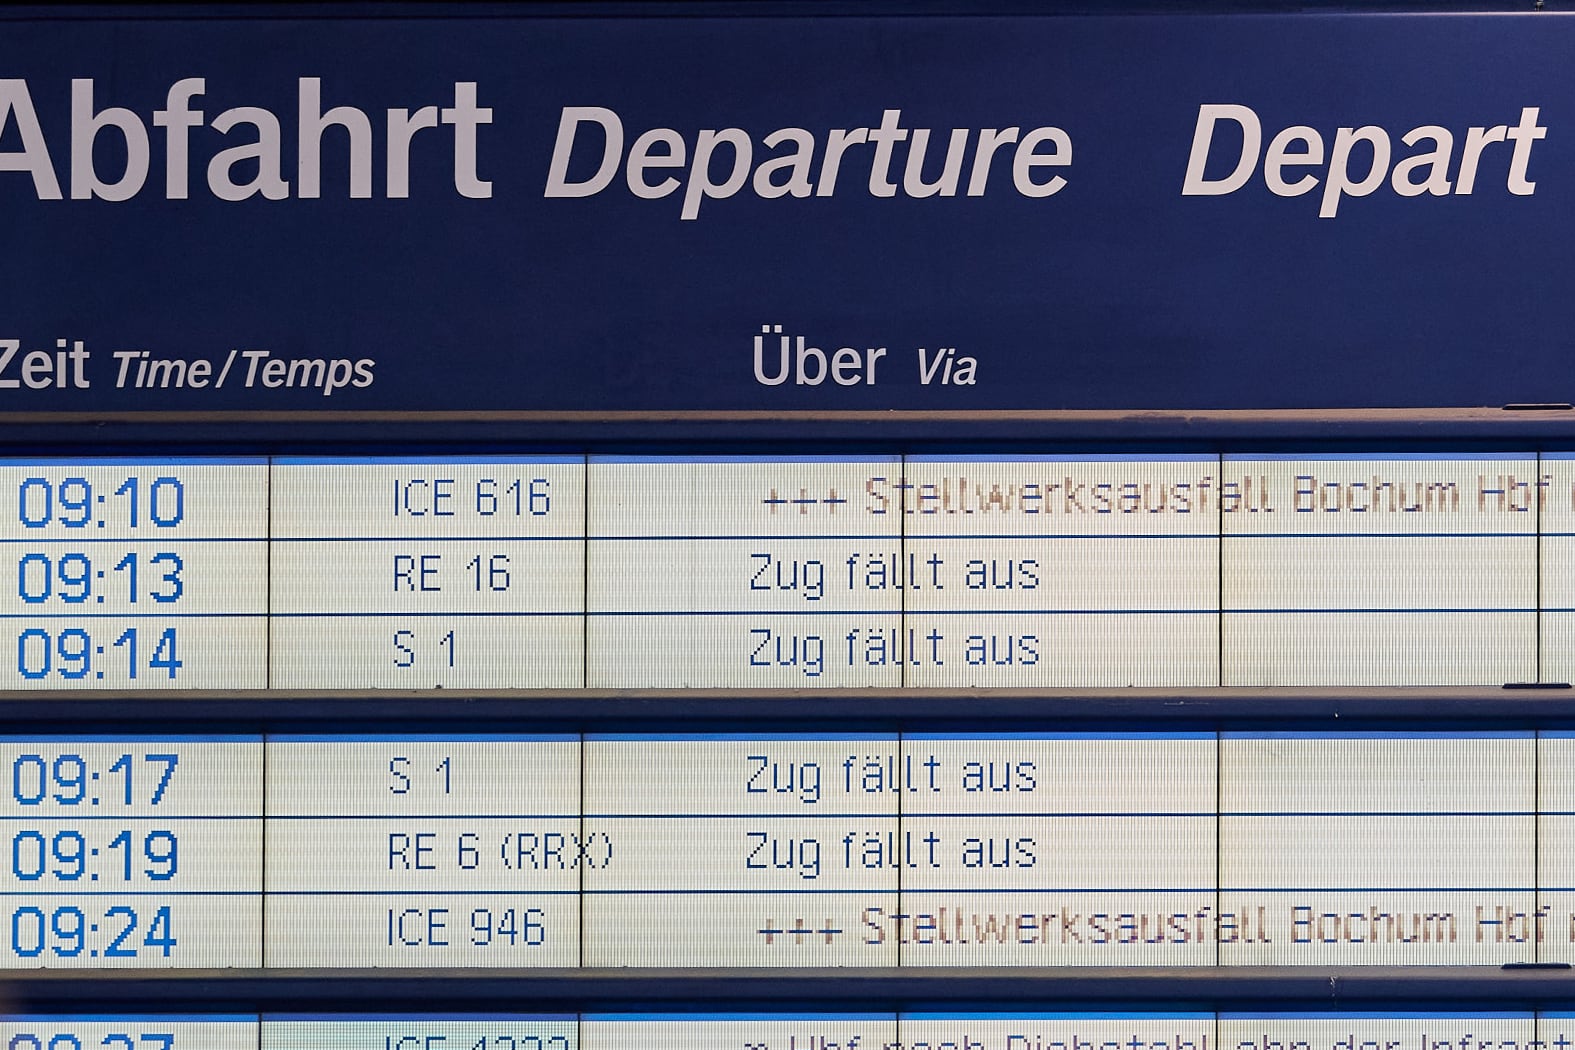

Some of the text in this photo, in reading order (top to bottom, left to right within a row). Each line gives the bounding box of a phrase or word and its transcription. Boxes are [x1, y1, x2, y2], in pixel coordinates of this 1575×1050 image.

[0, 77, 1073, 220] Abfahrt Departure
[1181, 103, 1547, 218] Depart
[0, 339, 90, 389] Zeit
[752, 324, 977, 386] Über Via
[18, 476, 185, 528] 09:10
[394, 478, 551, 516] ICE 616
[865, 476, 1274, 515] Stellwerksausfall
[1294, 475, 1459, 513] Bochum
[1478, 475, 1552, 513] Hbf
[18, 552, 185, 604] 09:13
[394, 554, 512, 592] RE 16
[749, 552, 1040, 601] Zug fällt aus
[18, 627, 184, 679] 09:14
[394, 630, 456, 667] S 1
[749, 629, 1040, 677] Zug fällt aus
[11, 754, 179, 806] 09:17
[389, 756, 452, 794] S 1
[746, 755, 1037, 803] Zug fällt aus
[11, 830, 179, 881] 09:19
[388, 833, 613, 871] RE 6 (RRX)
[746, 832, 1037, 879] Zug fällt aus
[11, 906, 179, 958] 09:24
[388, 908, 546, 946] ICE 946
[862, 907, 1272, 944] Stellwerksausfall
[1292, 906, 1456, 943] Bochum
[1475, 906, 1551, 943] Hbf
